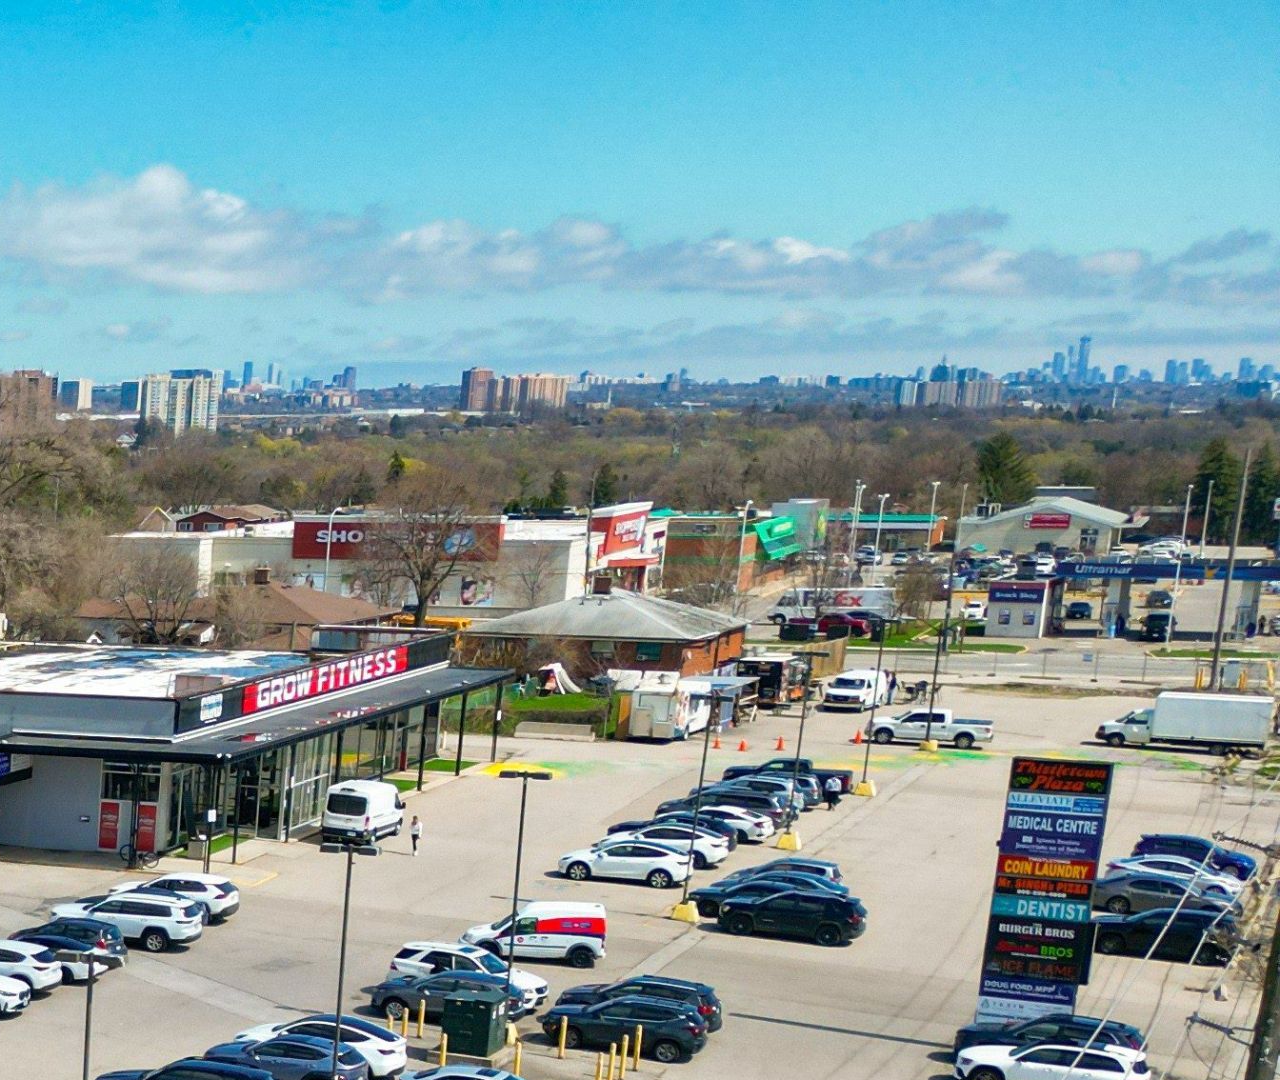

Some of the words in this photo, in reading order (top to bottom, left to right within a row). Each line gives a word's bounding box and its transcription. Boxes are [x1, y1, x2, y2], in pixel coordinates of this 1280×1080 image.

[1075, 564, 1132, 575] Ultramar
[257, 668, 312, 709] GROW
[317, 649, 397, 693] FITNESS
[1030, 774, 1084, 791] Plaza
[1008, 815, 1053, 831] MEDICAL
[1056, 819, 1098, 835] CENTRE
[1004, 860, 1032, 874] COIN
[1035, 863, 1088, 879] LAUNDRY
[1017, 899, 1087, 921] DENTIST
[999, 923, 1042, 936] BURGER
[1045, 928, 1075, 939] BROS
[1041, 945, 1073, 958] BROS
